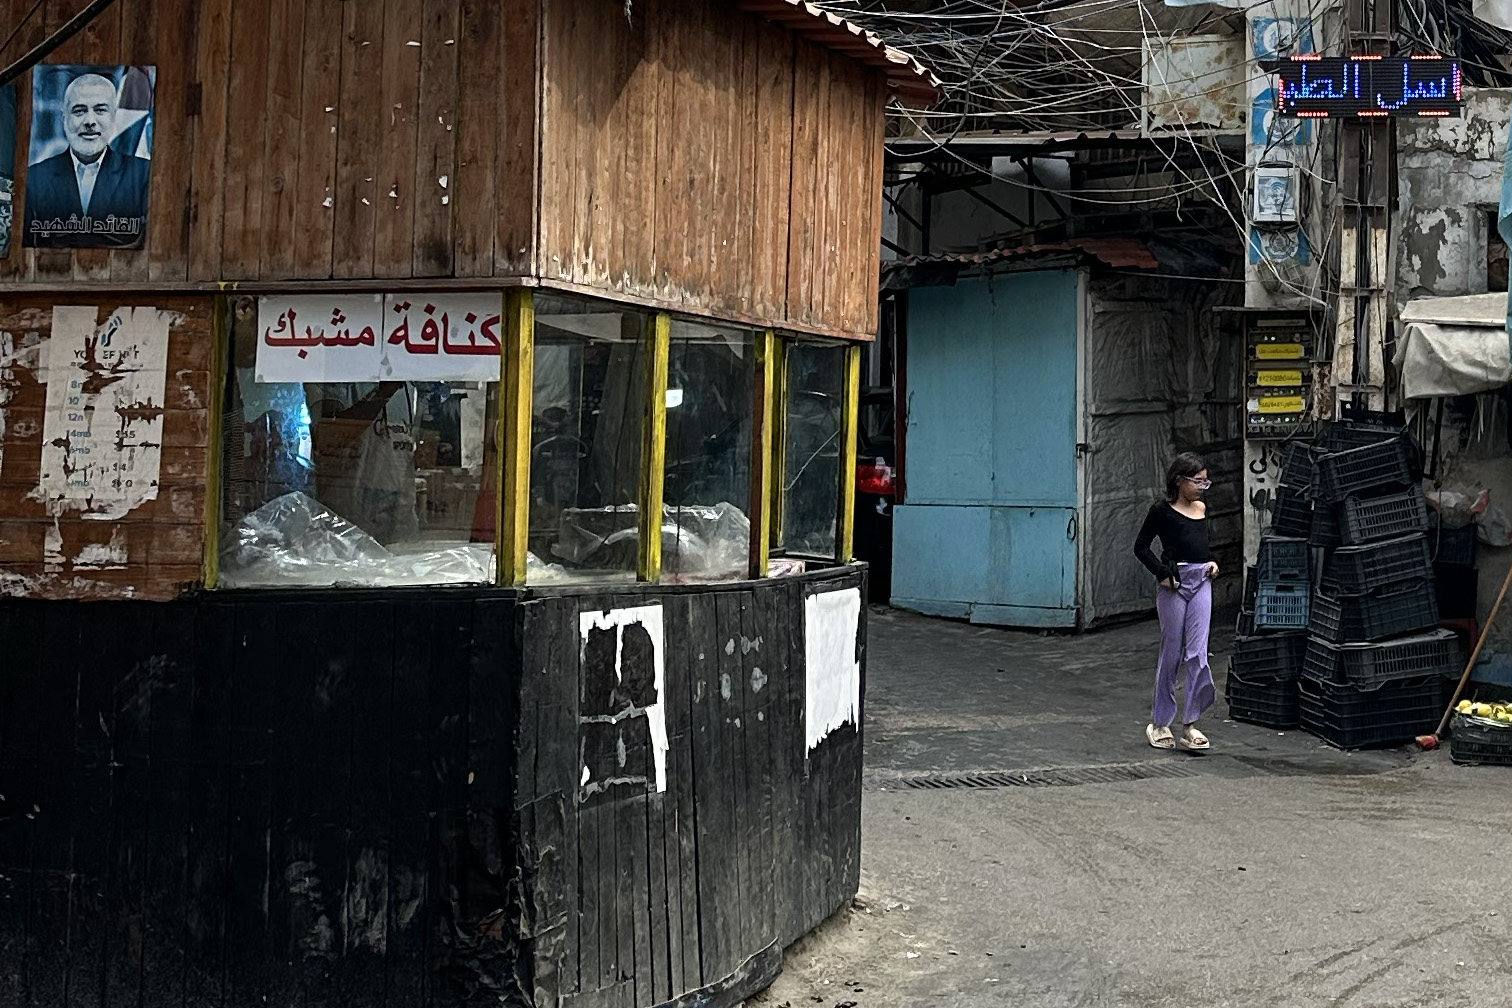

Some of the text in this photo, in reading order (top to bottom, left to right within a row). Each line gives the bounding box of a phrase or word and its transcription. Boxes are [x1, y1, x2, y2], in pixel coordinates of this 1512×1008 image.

[30, 213, 141, 237] القائد الشهيد
[264, 300, 502, 360] كنافة مشبك
